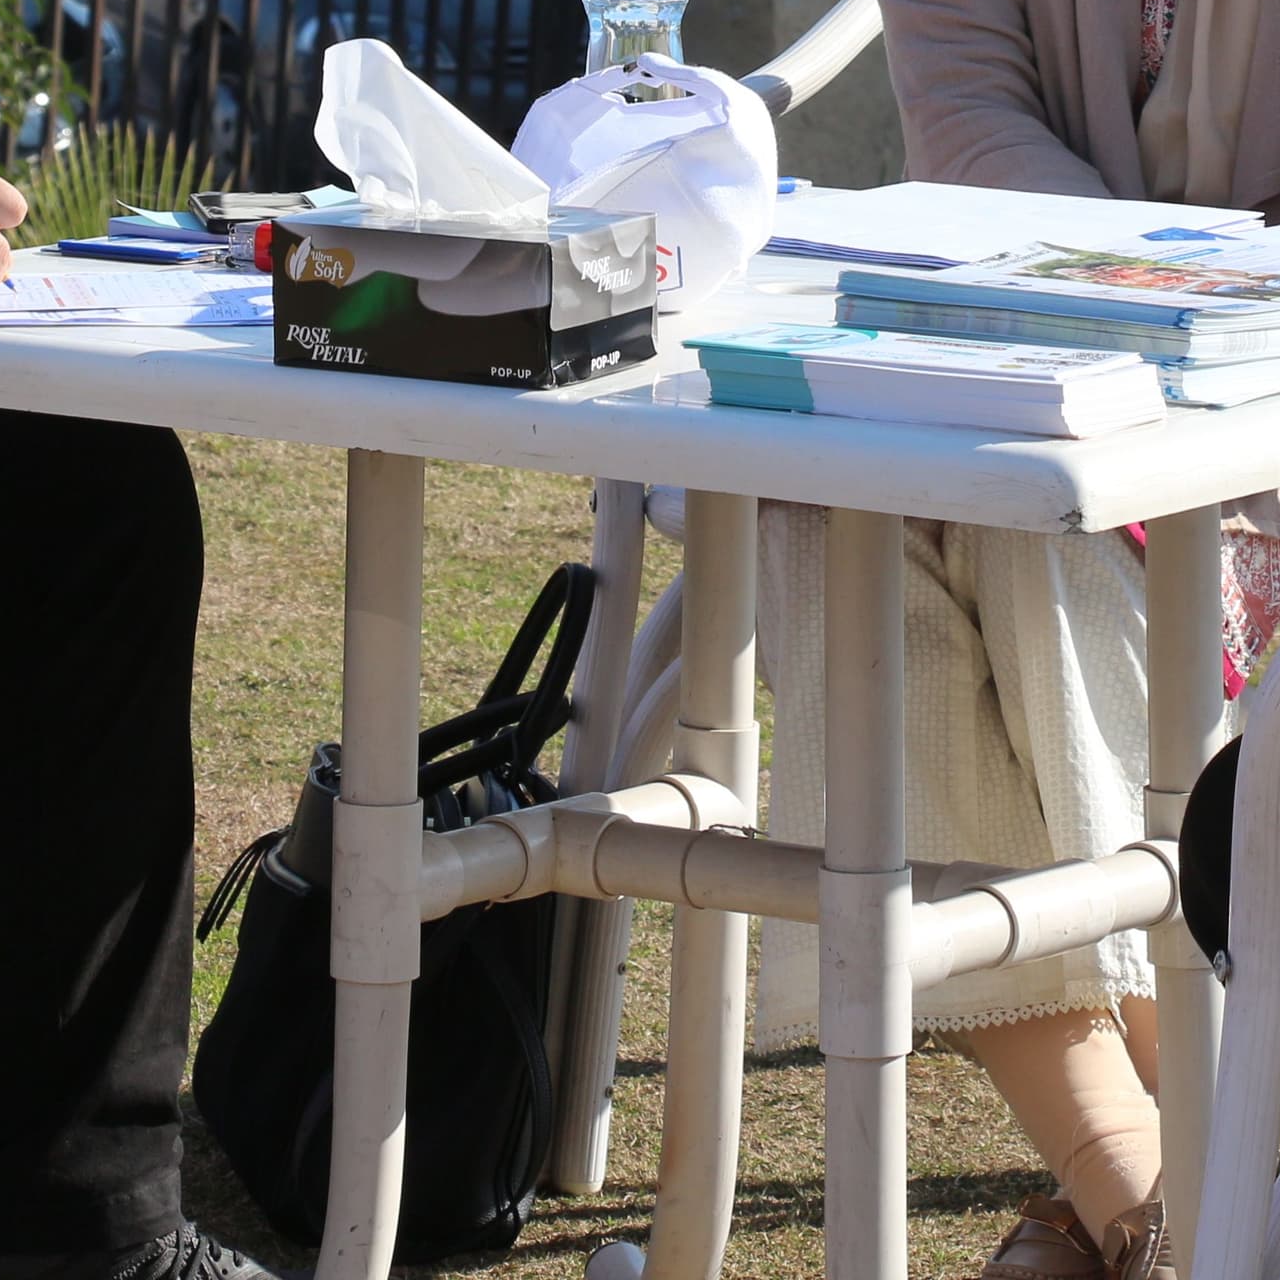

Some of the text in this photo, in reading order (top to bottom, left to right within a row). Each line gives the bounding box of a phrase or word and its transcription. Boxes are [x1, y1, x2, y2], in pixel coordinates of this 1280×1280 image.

[311, 250, 333, 262] Ultra
[314, 260, 345, 281] Soft
[581, 255, 611, 284] ROSE
[597, 267, 631, 294] PETAL
[286, 324, 332, 350] ROSE
[311, 344, 366, 365] PETAL
[591, 350, 621, 372] POP-UP
[490, 366, 532, 379] POP-UP
